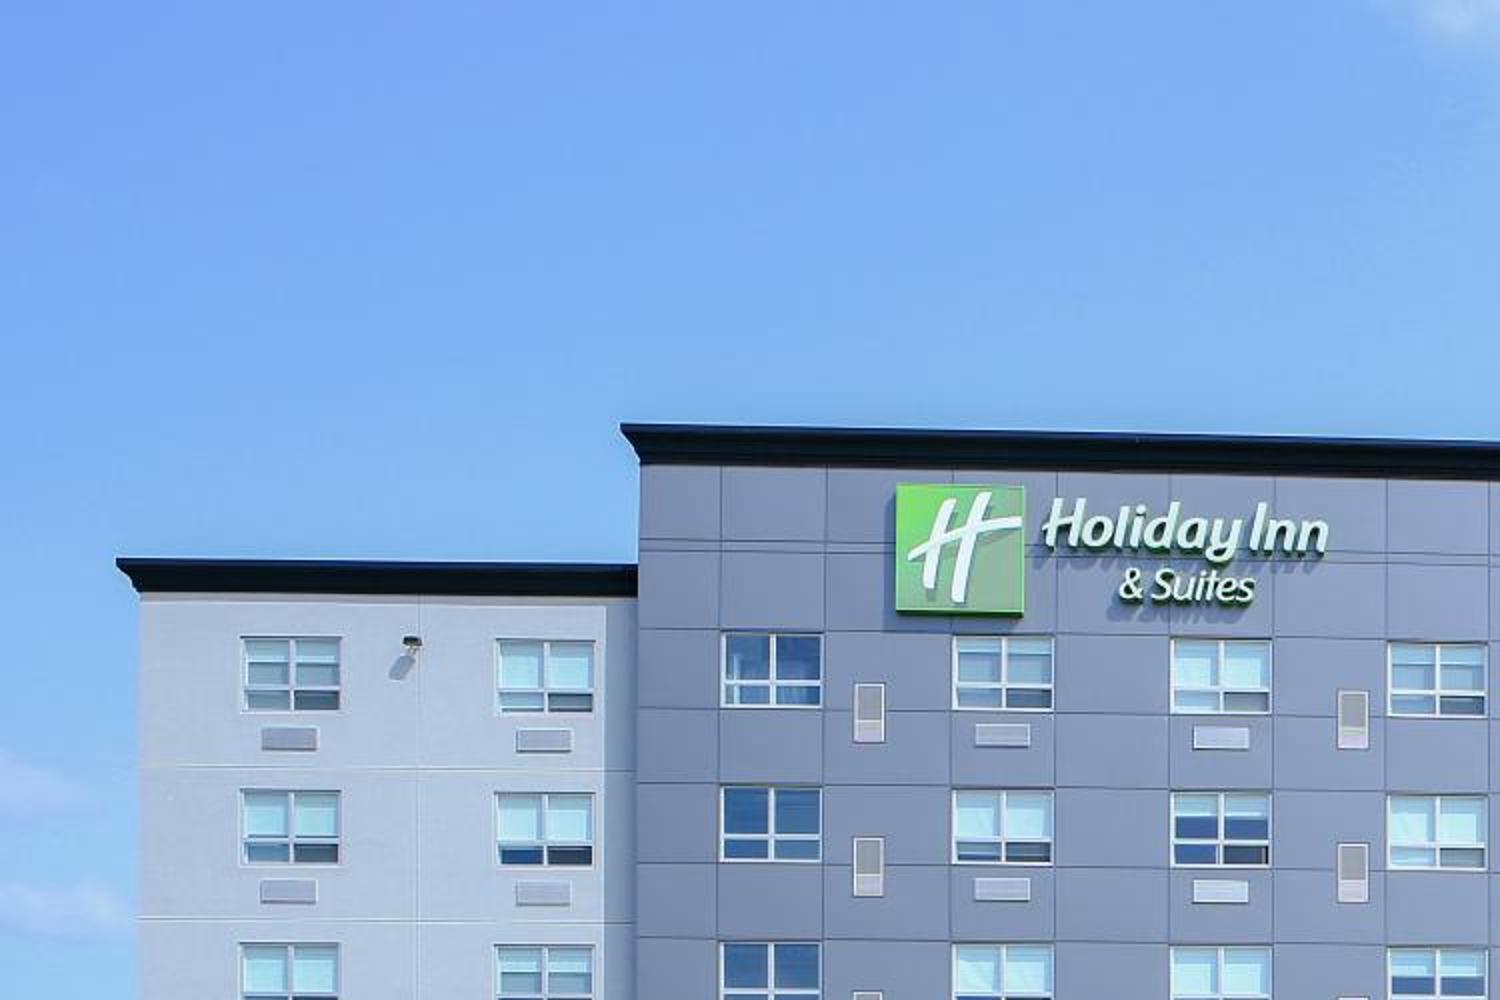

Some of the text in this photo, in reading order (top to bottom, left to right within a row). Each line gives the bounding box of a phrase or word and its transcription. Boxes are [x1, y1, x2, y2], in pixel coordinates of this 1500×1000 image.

[1042, 497, 1329, 563] Holiday Inn
[1119, 567, 1257, 604] & Suites
